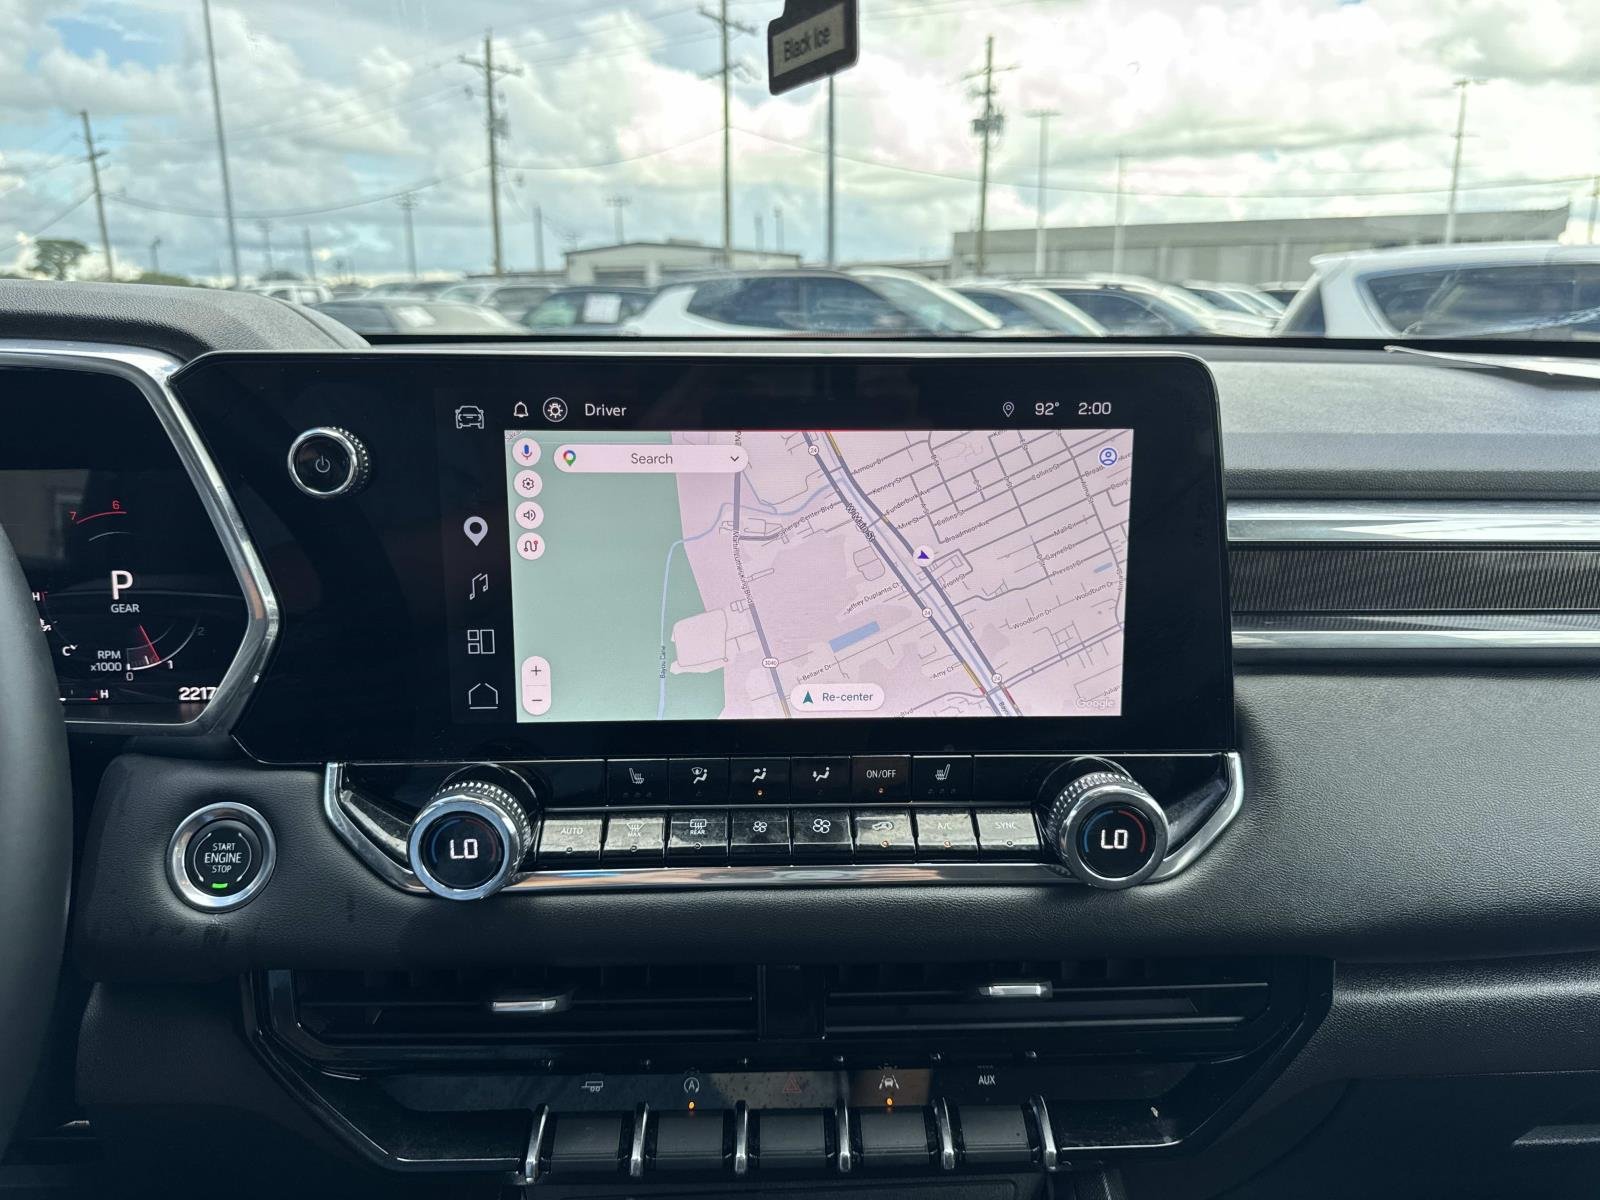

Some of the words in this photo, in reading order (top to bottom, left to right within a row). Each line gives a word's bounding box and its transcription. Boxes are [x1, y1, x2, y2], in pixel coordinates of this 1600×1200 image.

[783, 31, 812, 62] Black
[813, 26, 832, 49] Ice
[584, 403, 627, 417] Driver
[1077, 401, 1112, 415] 2:00
[630, 452, 674, 466] Search
[112, 500, 120, 510] 6
[69, 511, 77, 520] 7
[851, 511, 869, 533] Main
[110, 570, 133, 600] P
[32, 591, 41, 601] H
[1074, 584, 1106, 601] Woodburn
[110, 603, 140, 613] GEAR
[1013, 611, 1044, 630] Woodburn
[62, 645, 71, 656] C
[97, 650, 121, 660] RPM
[90, 662, 122, 671] x1000
[167, 660, 174, 669] 1
[126, 672, 134, 681] 0
[100, 689, 109, 699] H
[822, 692, 873, 702] Re-center
[1075, 697, 1116, 713] Google
[866, 769, 897, 779] ON/OFF
[937, 822, 953, 830] A/C
[994, 821, 1017, 830] SYNC
[560, 827, 584, 835] AUTO
[1101, 829, 1128, 850] LO
[212, 842, 237, 852] START
[450, 838, 478, 860] LO
[204, 852, 243, 864] ENGINE
[211, 864, 232, 874] STOP
[978, 1074, 997, 1086] AUX
